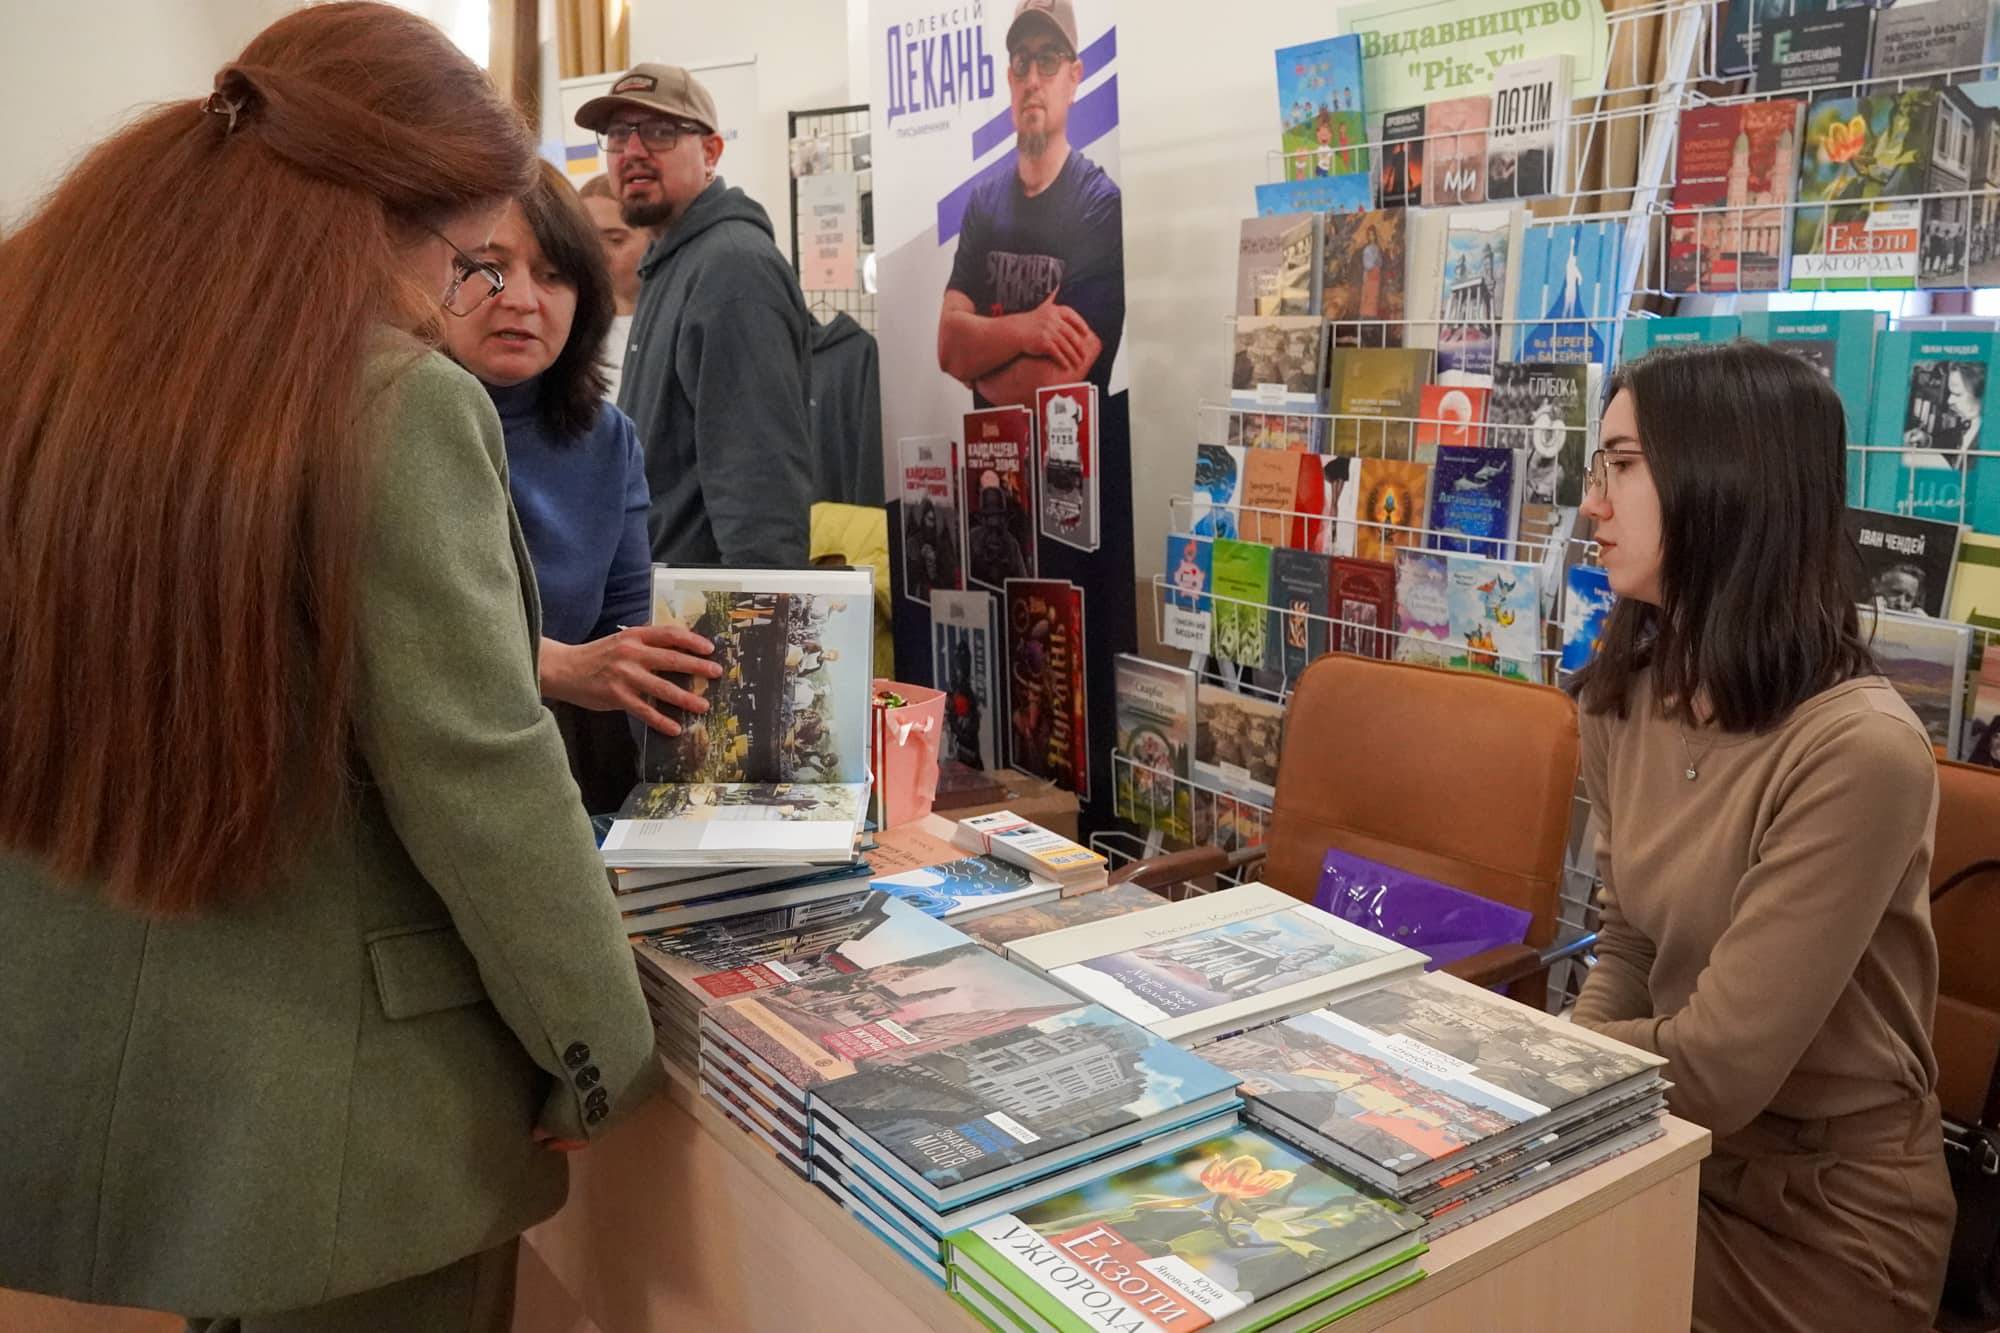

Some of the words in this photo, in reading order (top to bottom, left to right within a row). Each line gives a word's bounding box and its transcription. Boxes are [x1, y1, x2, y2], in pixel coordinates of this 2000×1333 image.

[905, 0, 983, 38] ОЛЕКСІЙ
[1362, 0, 1581, 59] Видавництво
[887, 25, 994, 129] ДЕКАНЬ
[1494, 81, 1552, 137] ПОТІМ
[1444, 169, 1477, 193] МИ
[1859, 528, 1884, 548] ІВАН
[1885, 533, 1925, 555] ЧЕНДЕЙ
[910, 1134, 969, 1169] МІСЦЯ
[936, 1129, 985, 1160] ЗНАКОВІ
[993, 1225, 1145, 1333] УЖГОРОДА
[1153, 1264, 1212, 1305] Яновський
[1192, 1276, 1225, 1300] Юрій
